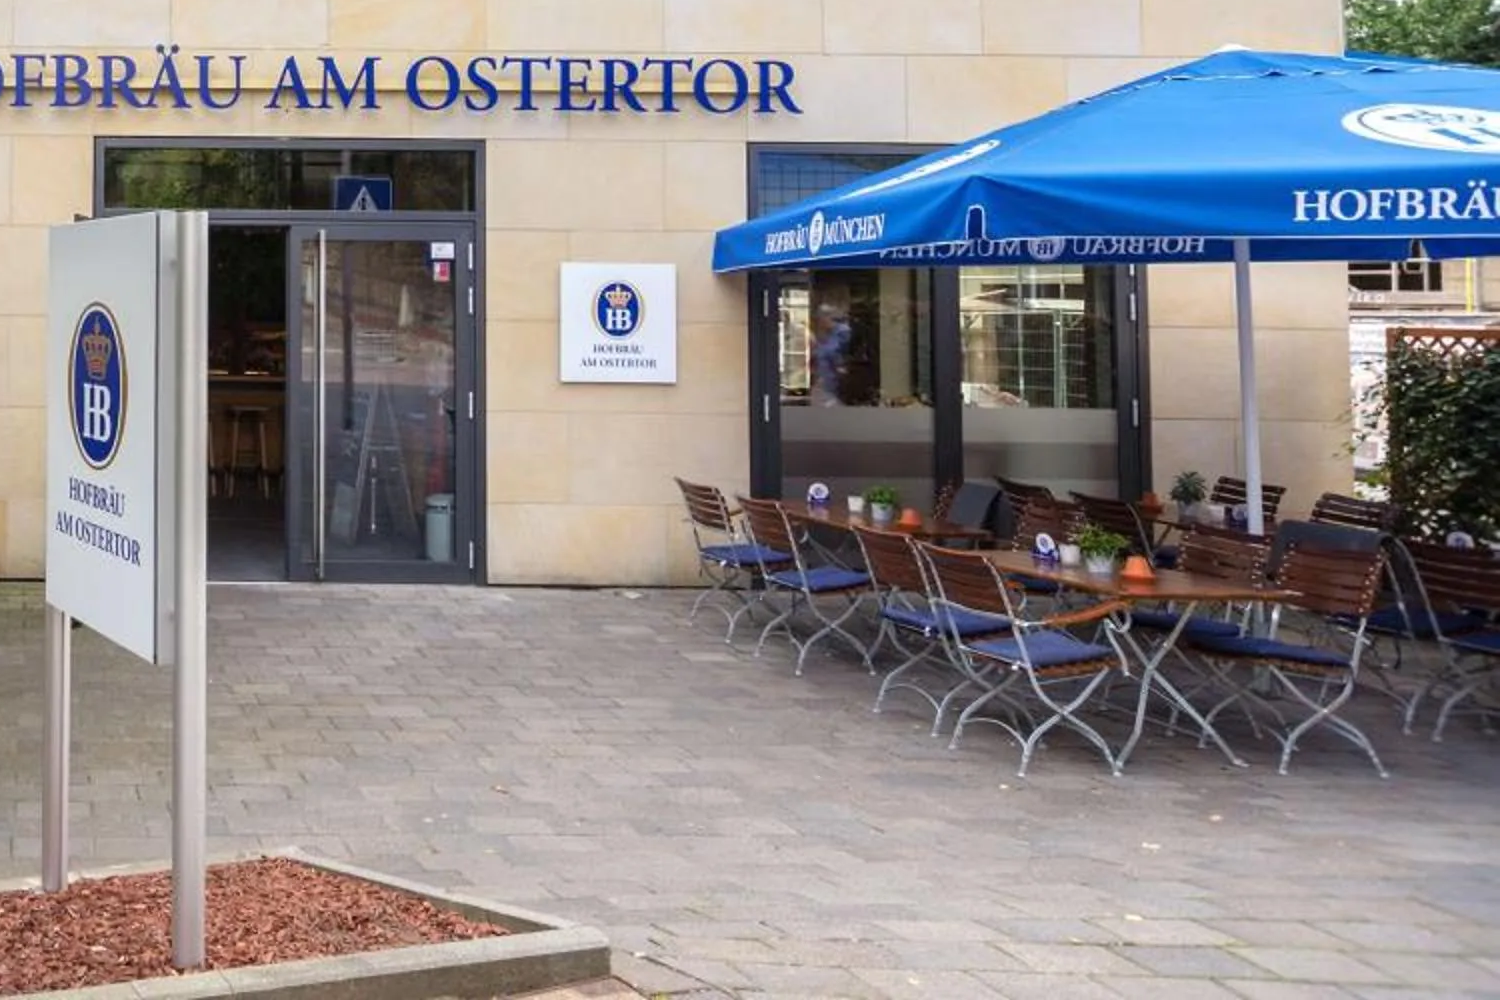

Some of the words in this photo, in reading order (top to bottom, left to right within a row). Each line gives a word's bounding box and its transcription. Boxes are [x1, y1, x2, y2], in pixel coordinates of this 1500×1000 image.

[264, 55, 381, 110] AM
[405, 55, 804, 115] OSTERTOR
[1292, 179, 1500, 222] HOFBRÄ
[823, 213, 885, 246] MÜNCHEN
[605, 308, 632, 330] HB
[581, 358, 598, 368] AM
[600, 358, 657, 369] OSTERTOR
[83, 383, 111, 442] HB
[68, 476, 126, 518] HOFBRÄU
[55, 511, 73, 537] AM
[75, 516, 141, 568] OSTERTOR
